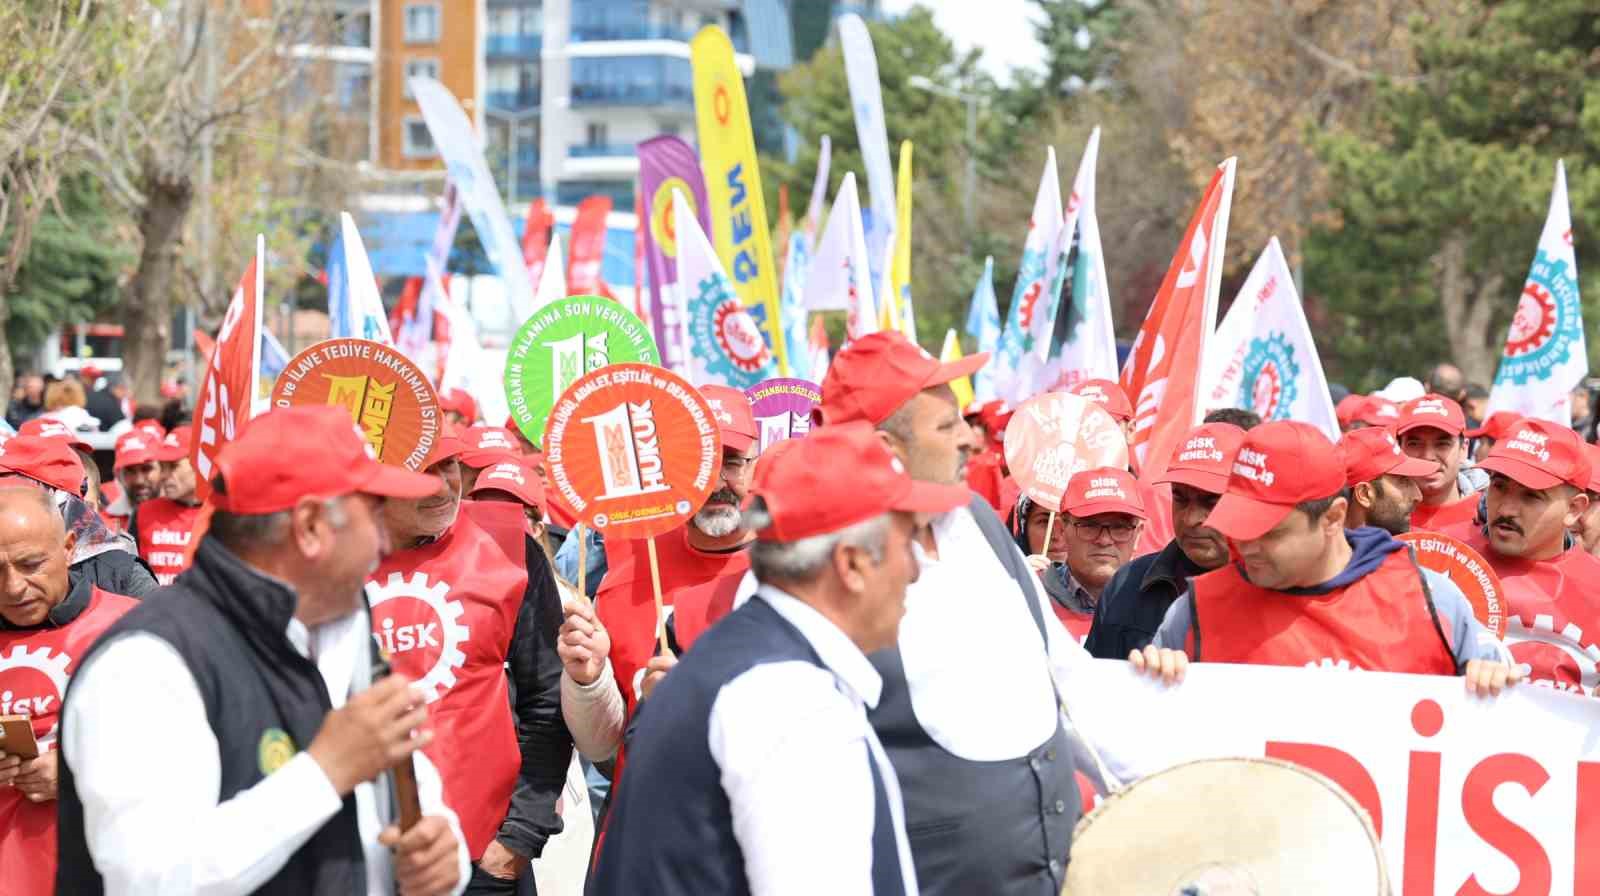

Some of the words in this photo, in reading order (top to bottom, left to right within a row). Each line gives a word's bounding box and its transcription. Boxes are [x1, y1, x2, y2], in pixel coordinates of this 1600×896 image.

[564, 303, 592, 316] SON
[594, 304, 645, 346] VERİLSİN
[285, 352, 324, 382] İLAVE
[321, 341, 371, 361] TEDİYE
[283, 382, 297, 397] ve
[373, 349, 431, 403] HAKKIMIZI
[612, 368, 655, 385] EŞİTLİK
[665, 382, 714, 436] DEMOKRASİ
[630, 399, 665, 486] HUKUK
[1420, 538, 1457, 559] EŞİTLİK
[1466, 560, 1502, 614] DEMOKRASİ
